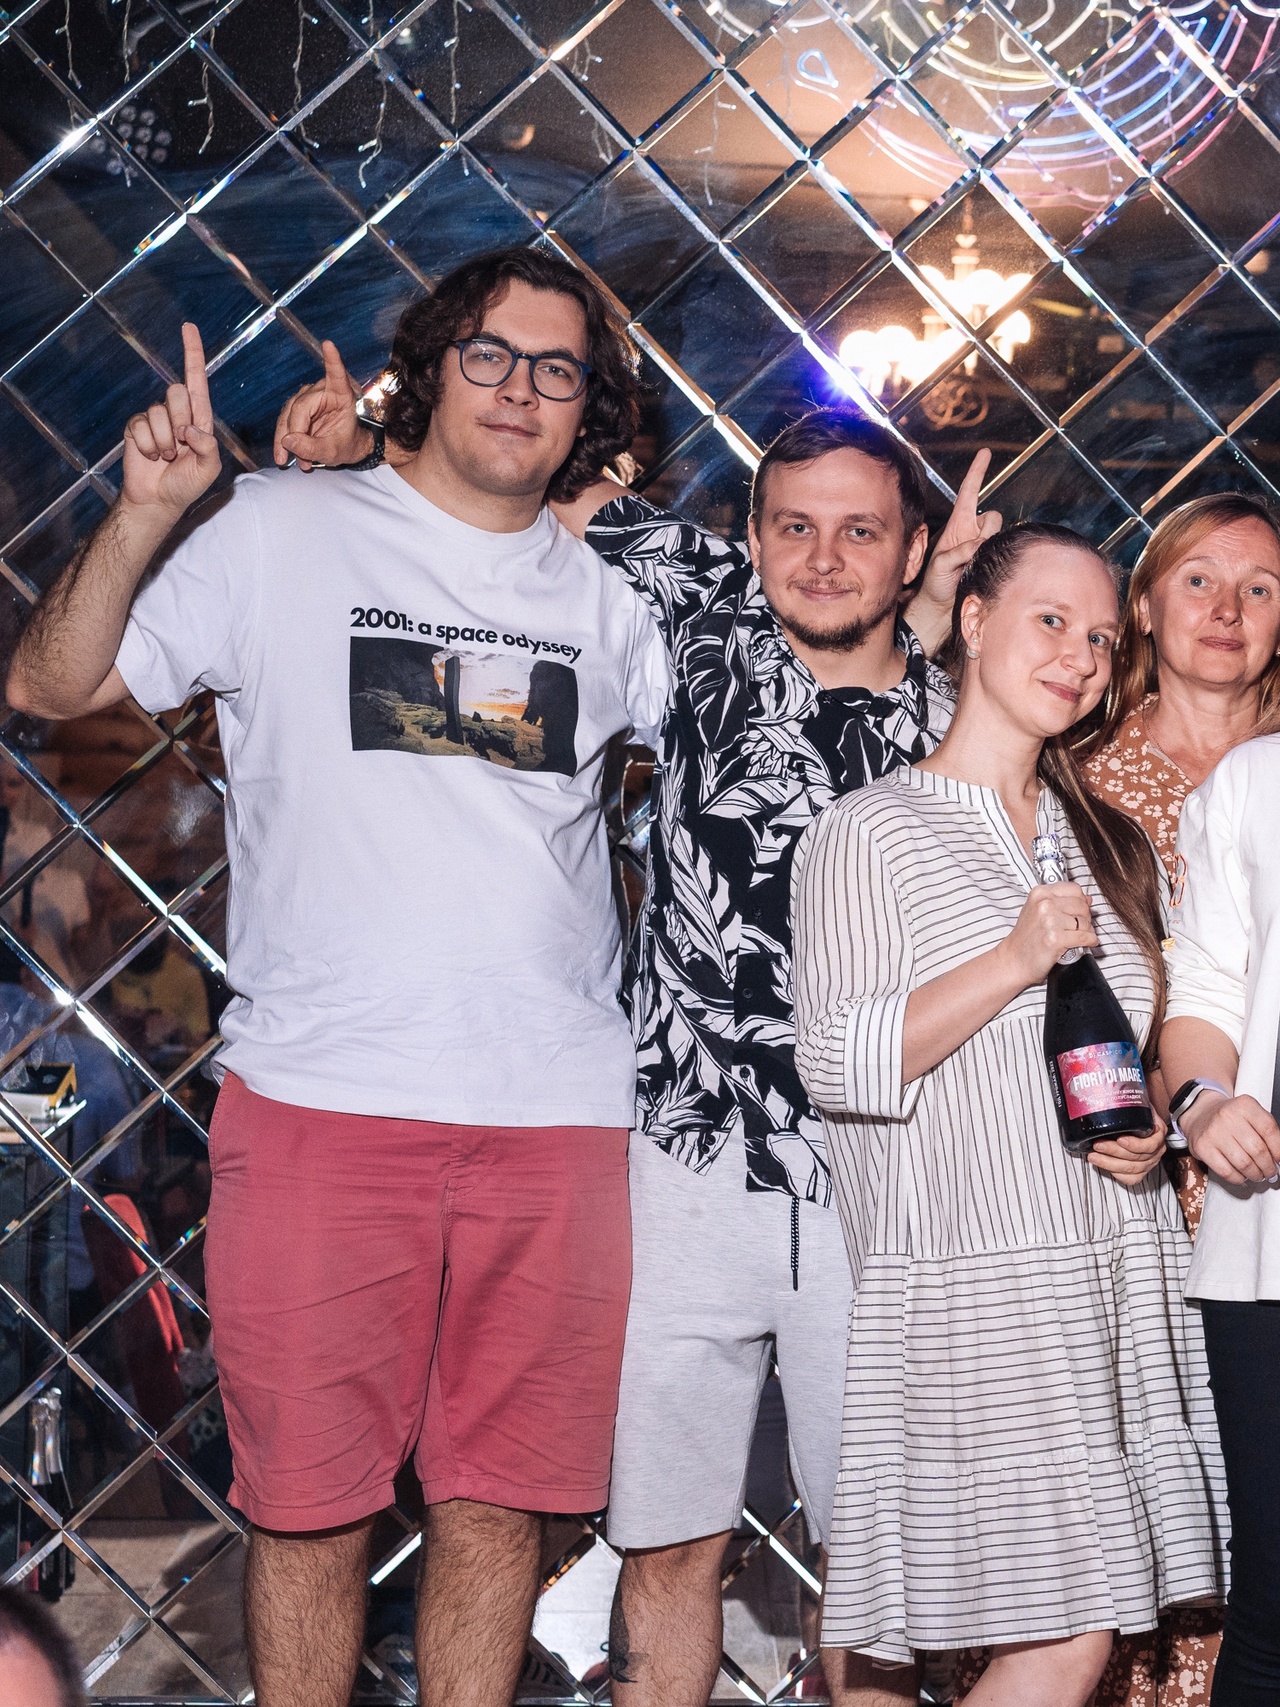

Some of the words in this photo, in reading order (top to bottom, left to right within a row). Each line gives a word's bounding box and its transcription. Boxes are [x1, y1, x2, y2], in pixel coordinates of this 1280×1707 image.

[350, 607, 414, 632] 2001:
[418, 622, 432, 636] a
[436, 625, 498, 644] space
[502, 633, 583, 664] odyssey
[1073, 1071, 1103, 1091] FIORI
[1105, 1068, 1118, 1084] DI
[1118, 1067, 1143, 1083] MARE
